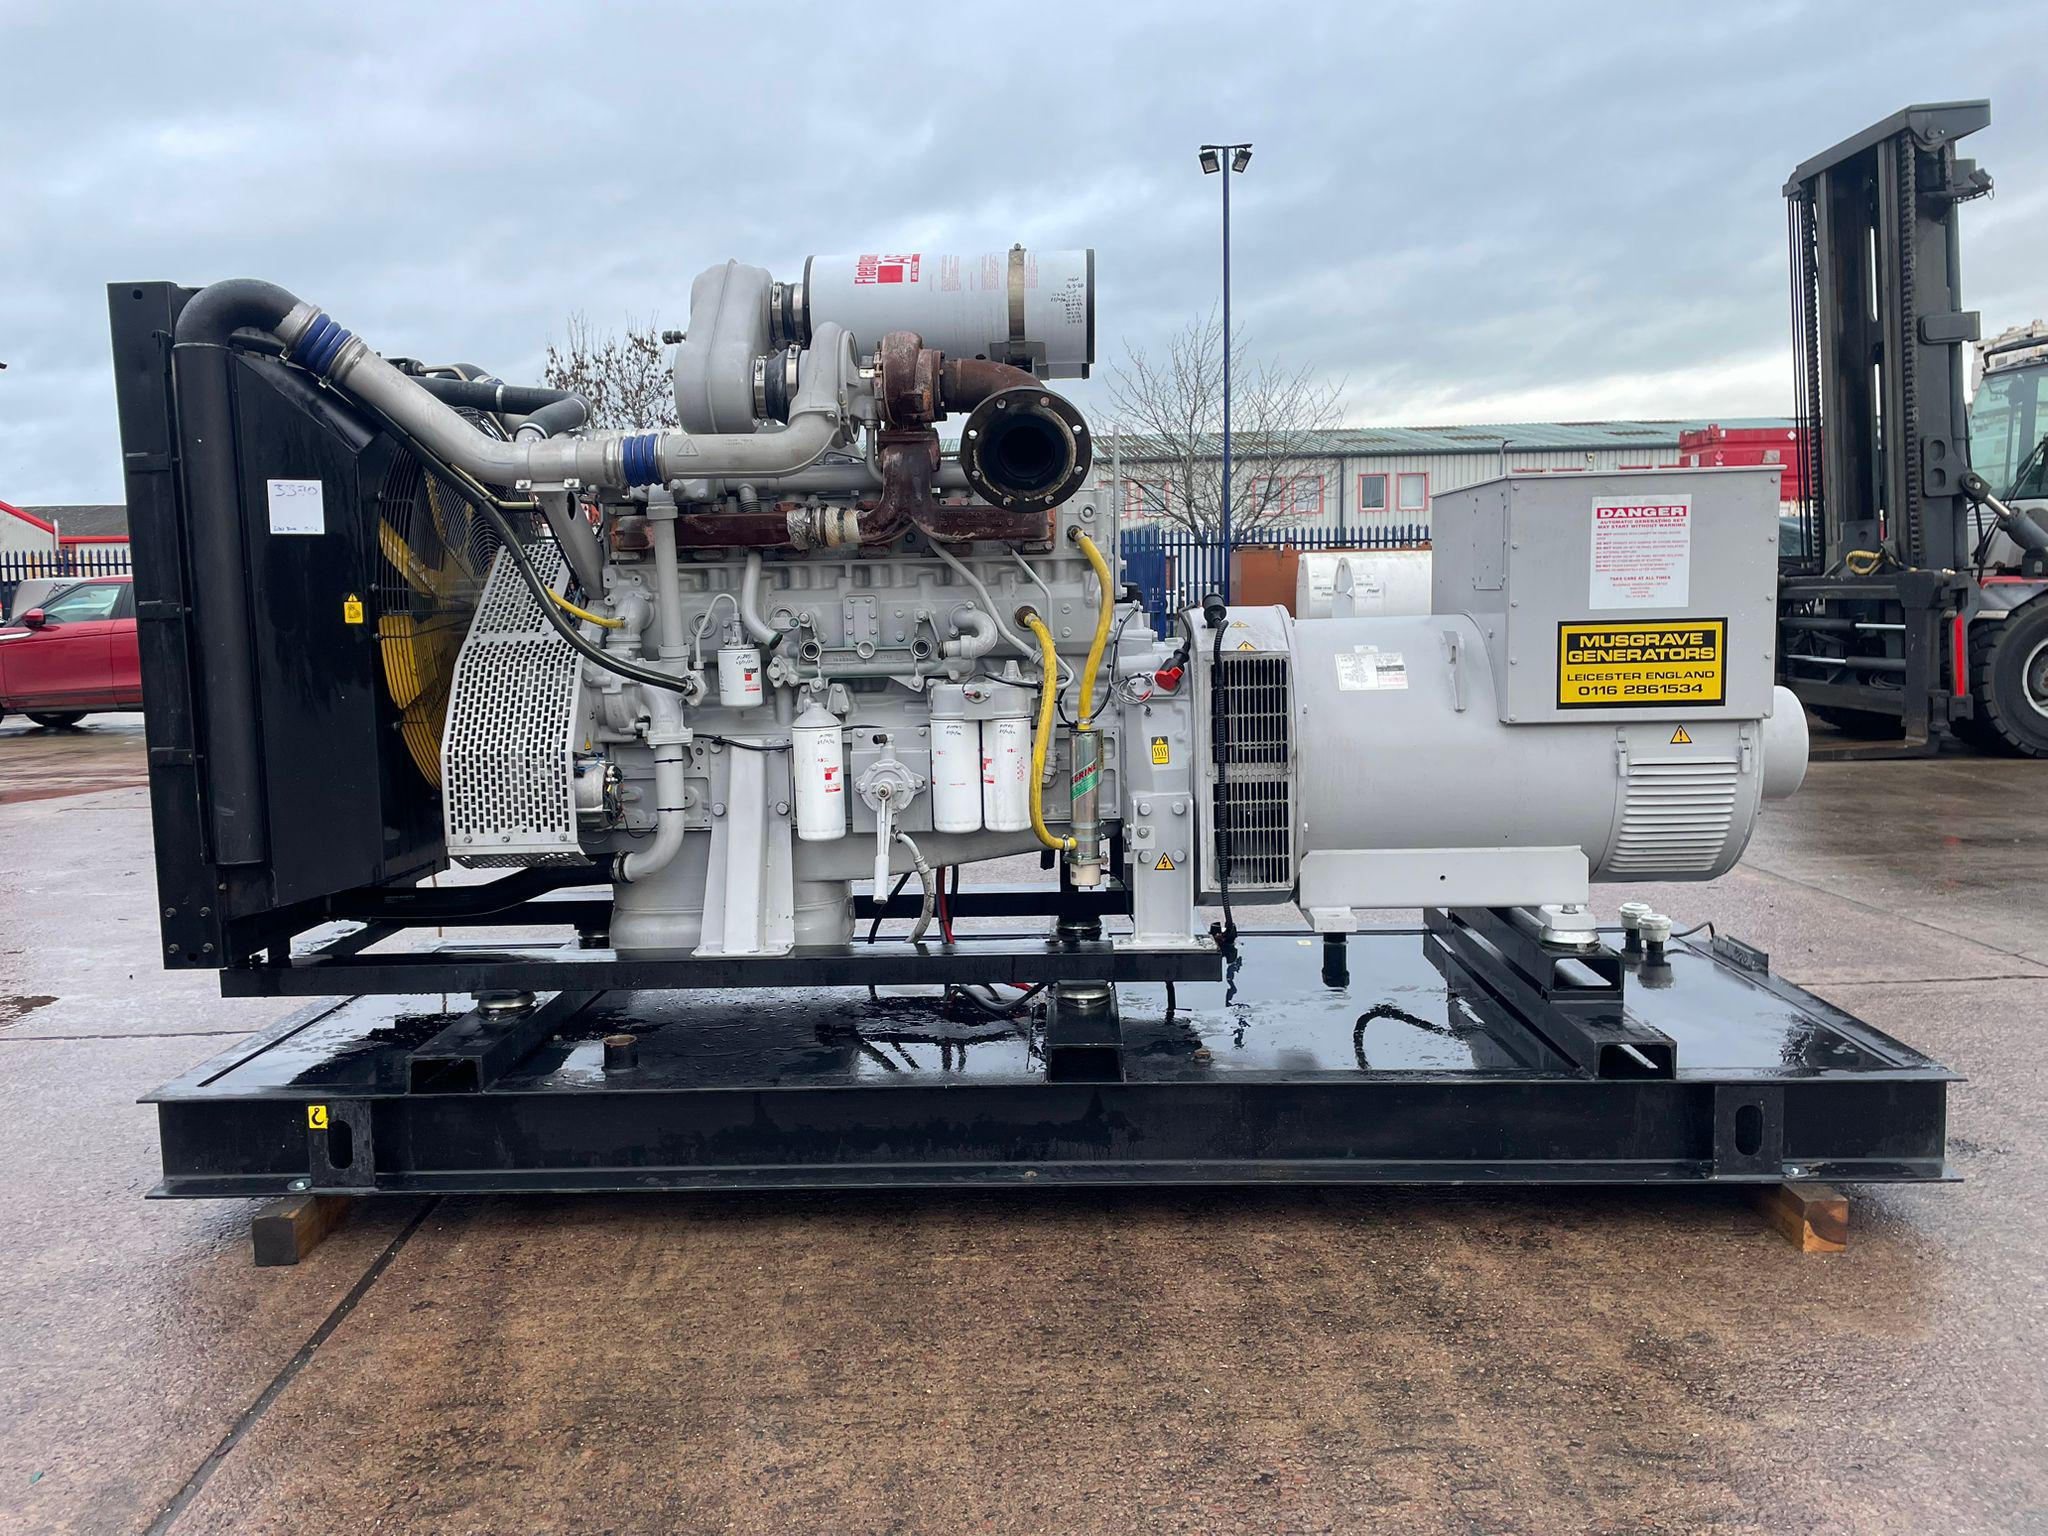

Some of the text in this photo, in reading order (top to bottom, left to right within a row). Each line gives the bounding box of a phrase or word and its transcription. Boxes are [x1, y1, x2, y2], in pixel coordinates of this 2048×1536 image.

[1600, 507, 1684, 518] DANGER
[1579, 633, 1703, 647] MUSGRAVE
[1568, 647, 1715, 663] GENERATORS
[1567, 671, 1715, 681] LEICESTER ENGLAND
[1578, 684, 1703, 695] 0116 2861534
